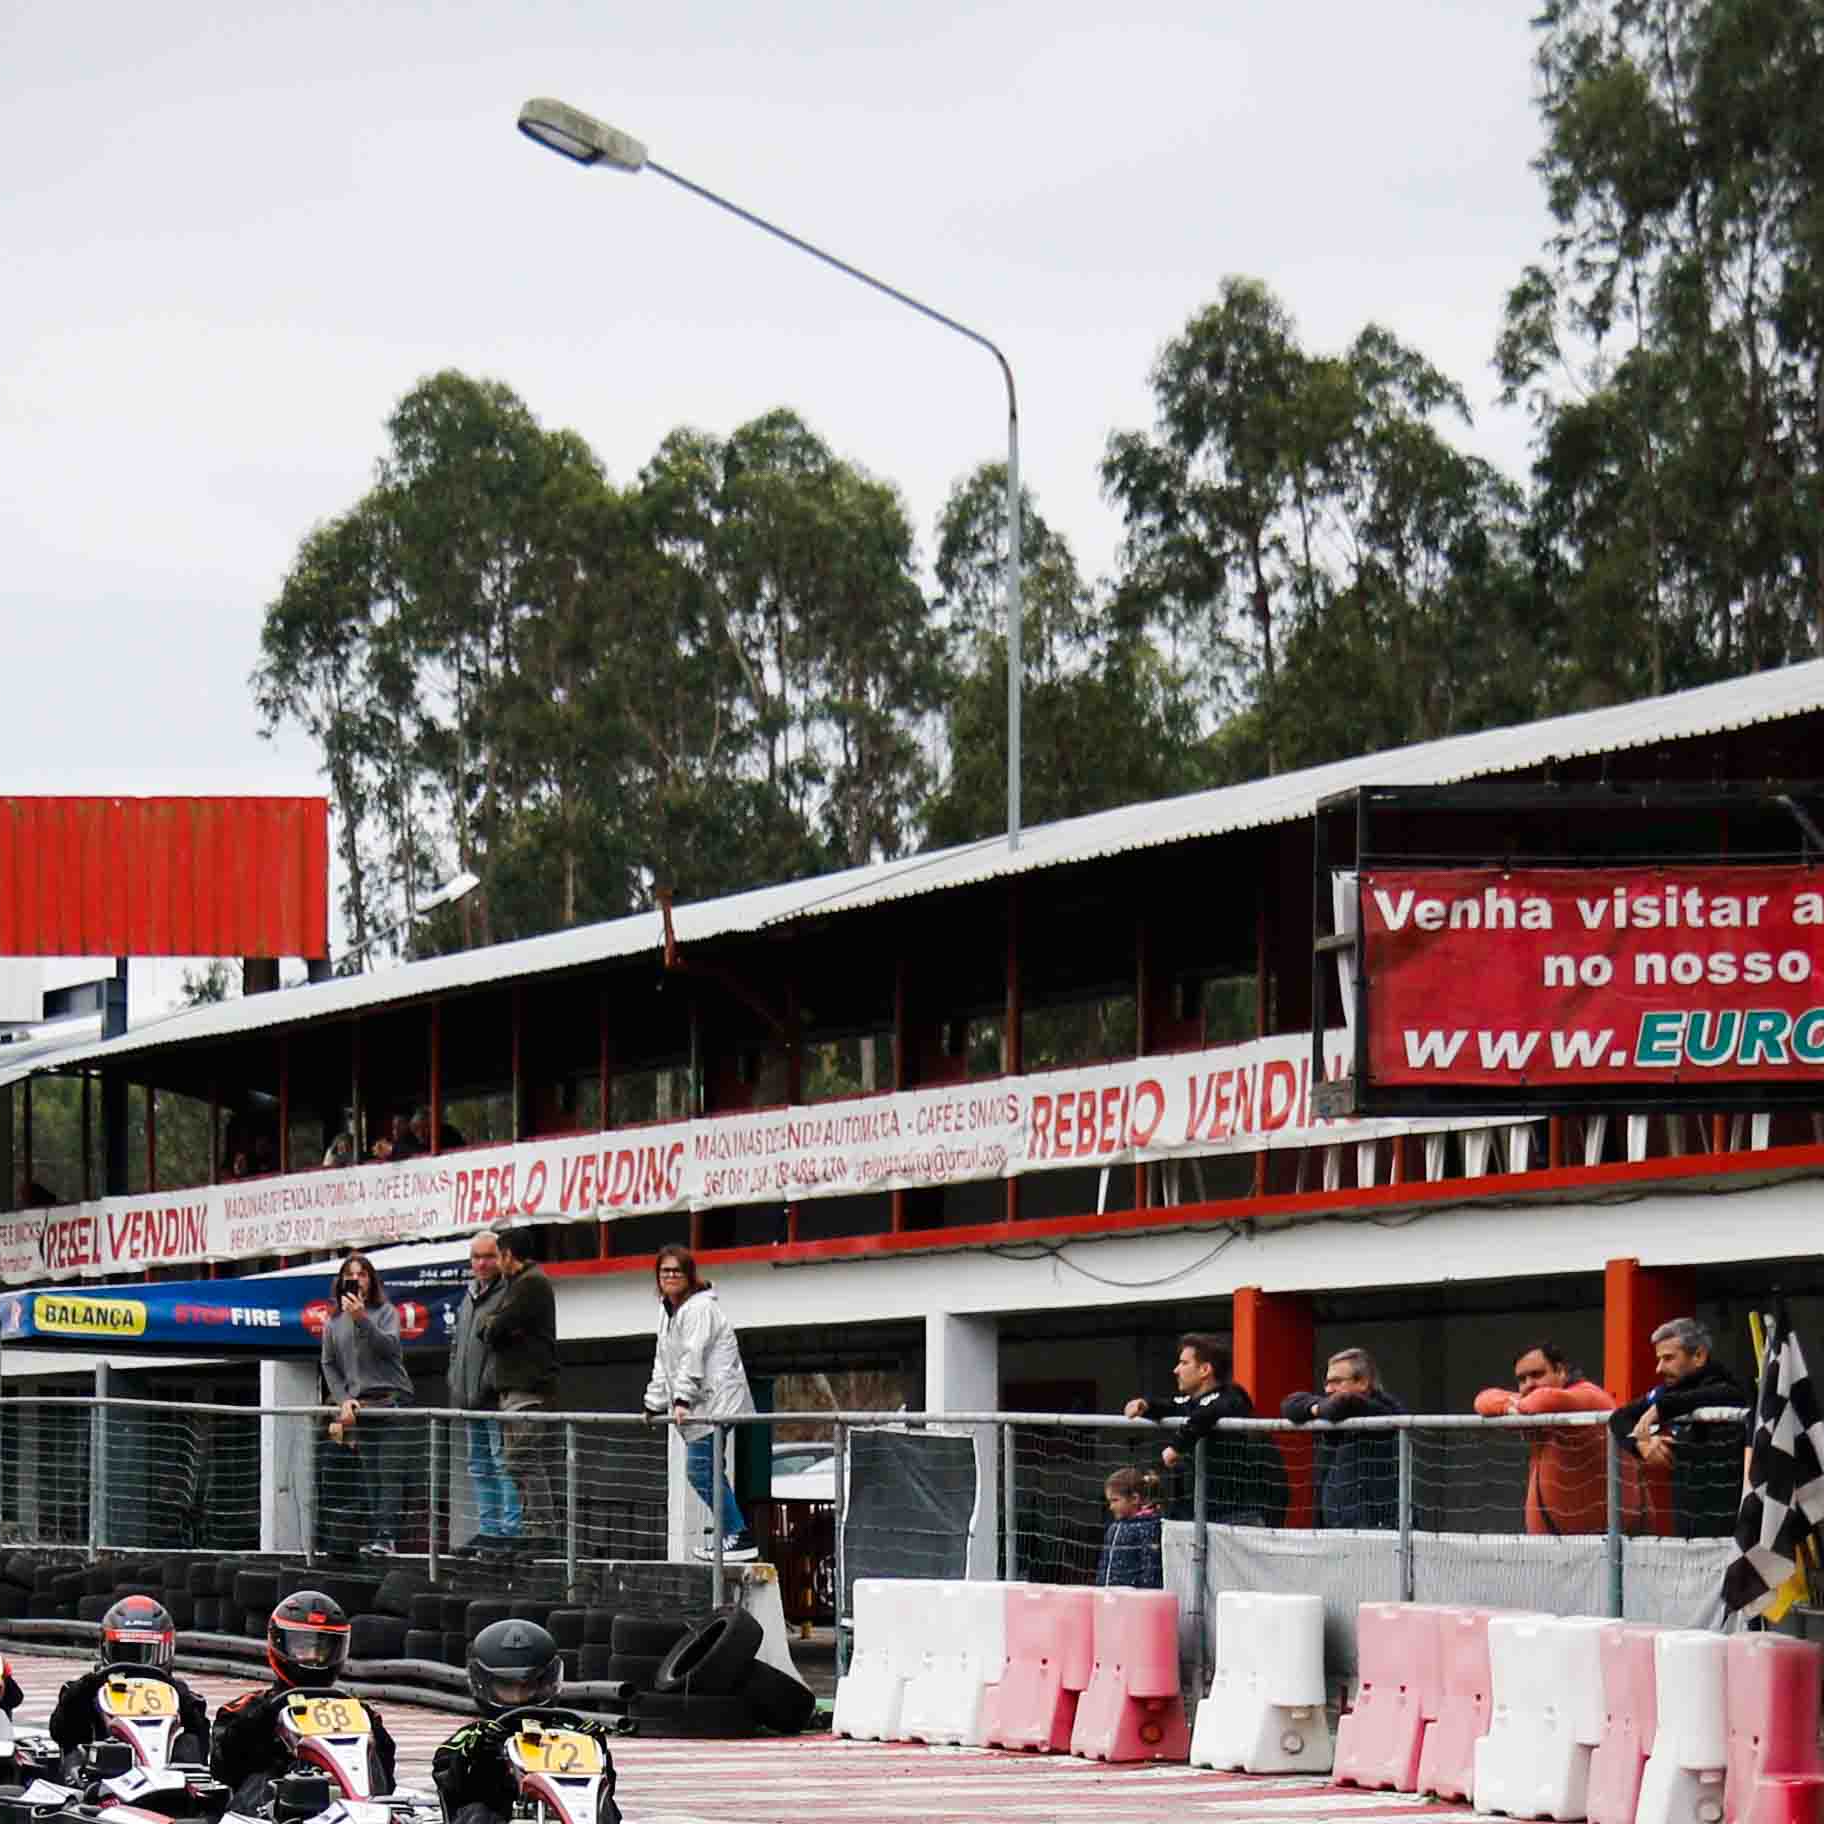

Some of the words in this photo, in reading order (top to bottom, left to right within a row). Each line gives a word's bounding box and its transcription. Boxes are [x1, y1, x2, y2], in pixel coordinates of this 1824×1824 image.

[1373, 887, 1553, 931] Venha
[1576, 885, 1769, 929] visitar
[1543, 953, 1614, 987] no
[1634, 949, 1811, 985] nosso
[1185, 1054, 1362, 1142] VENDI
[559, 1141, 684, 1213] VENDING
[44, 1303, 135, 1331] BALANÇA
[126, 1687, 162, 1711] 76
[312, 1703, 352, 1728] 68
[540, 1742, 585, 1769] 72
